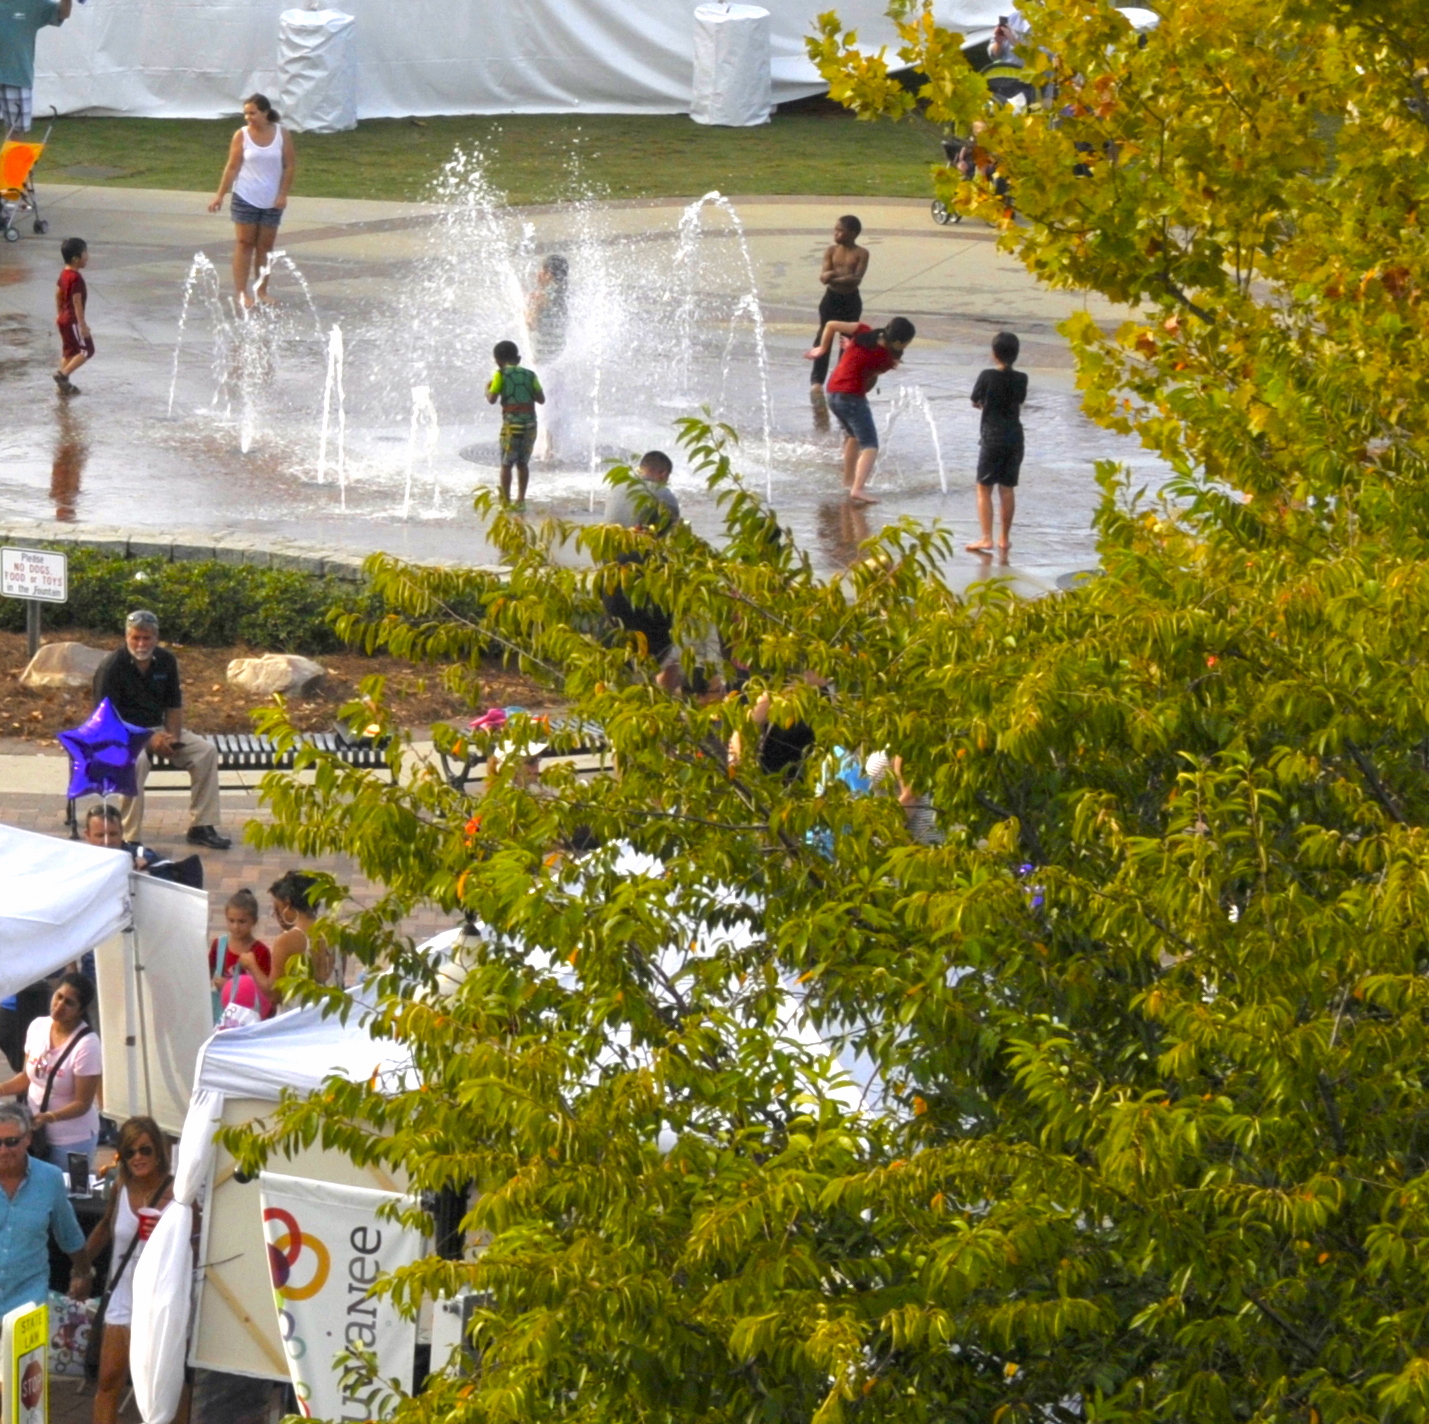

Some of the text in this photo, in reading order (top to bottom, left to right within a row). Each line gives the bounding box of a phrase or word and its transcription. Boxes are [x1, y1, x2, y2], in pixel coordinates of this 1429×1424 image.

[13, 562, 25, 572] NO
[4, 571, 26, 583] FOOD
[42, 575, 63, 587] TOYS
[21, 1311, 43, 1335] STATE
[24, 1330, 40, 1350] LAW
